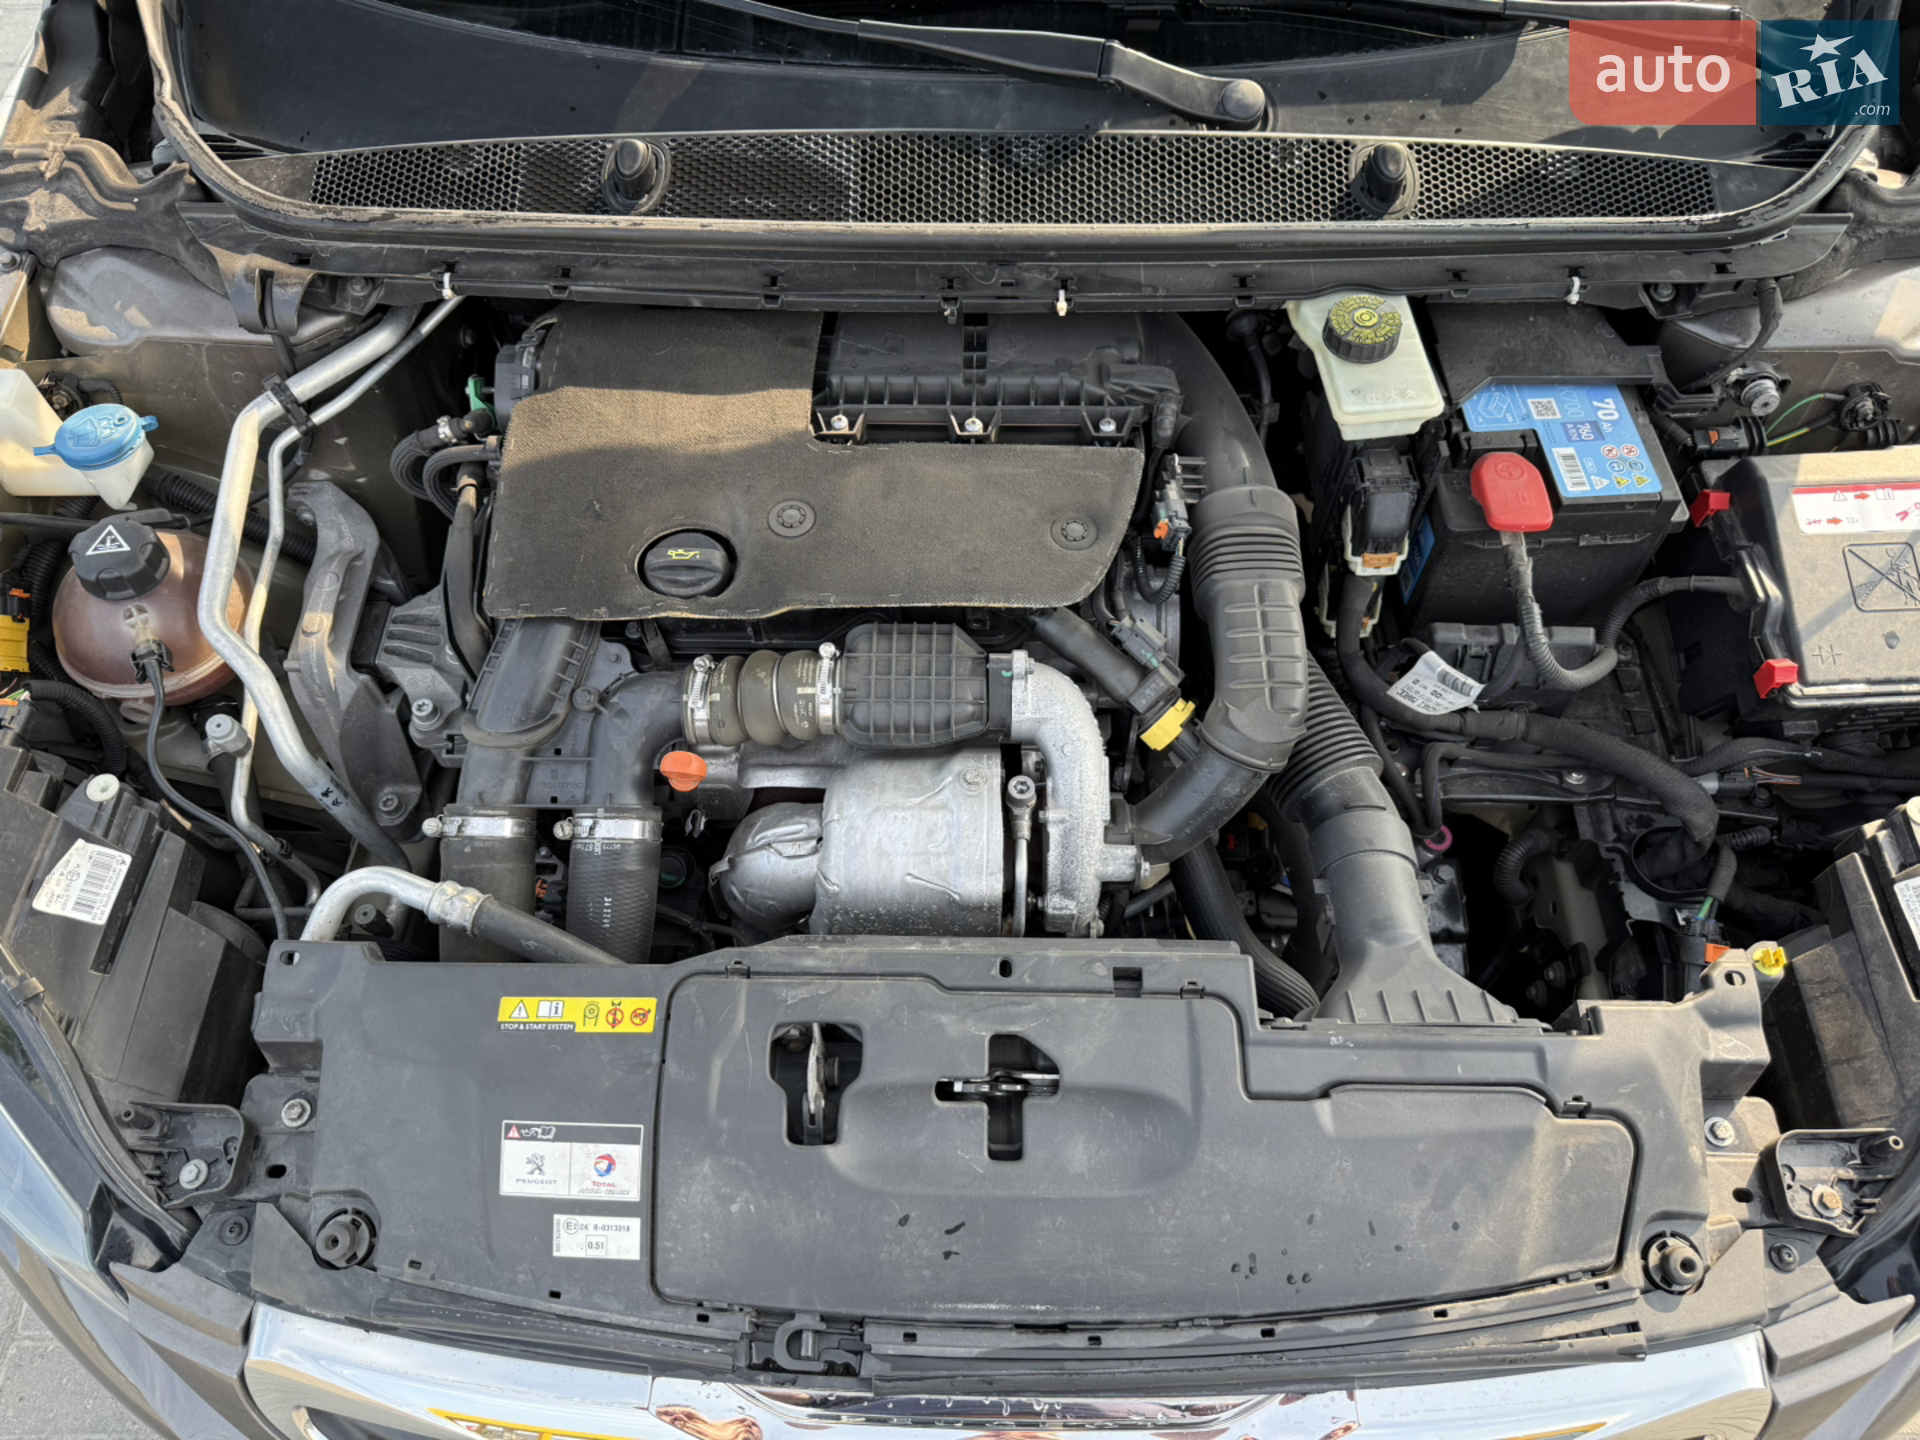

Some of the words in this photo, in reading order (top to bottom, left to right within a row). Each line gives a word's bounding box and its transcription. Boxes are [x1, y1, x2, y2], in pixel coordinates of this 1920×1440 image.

[1593, 398, 1620, 420] 70
[1577, 422, 1595, 441] 760
[587, 1241, 604, 1250] 0.51
